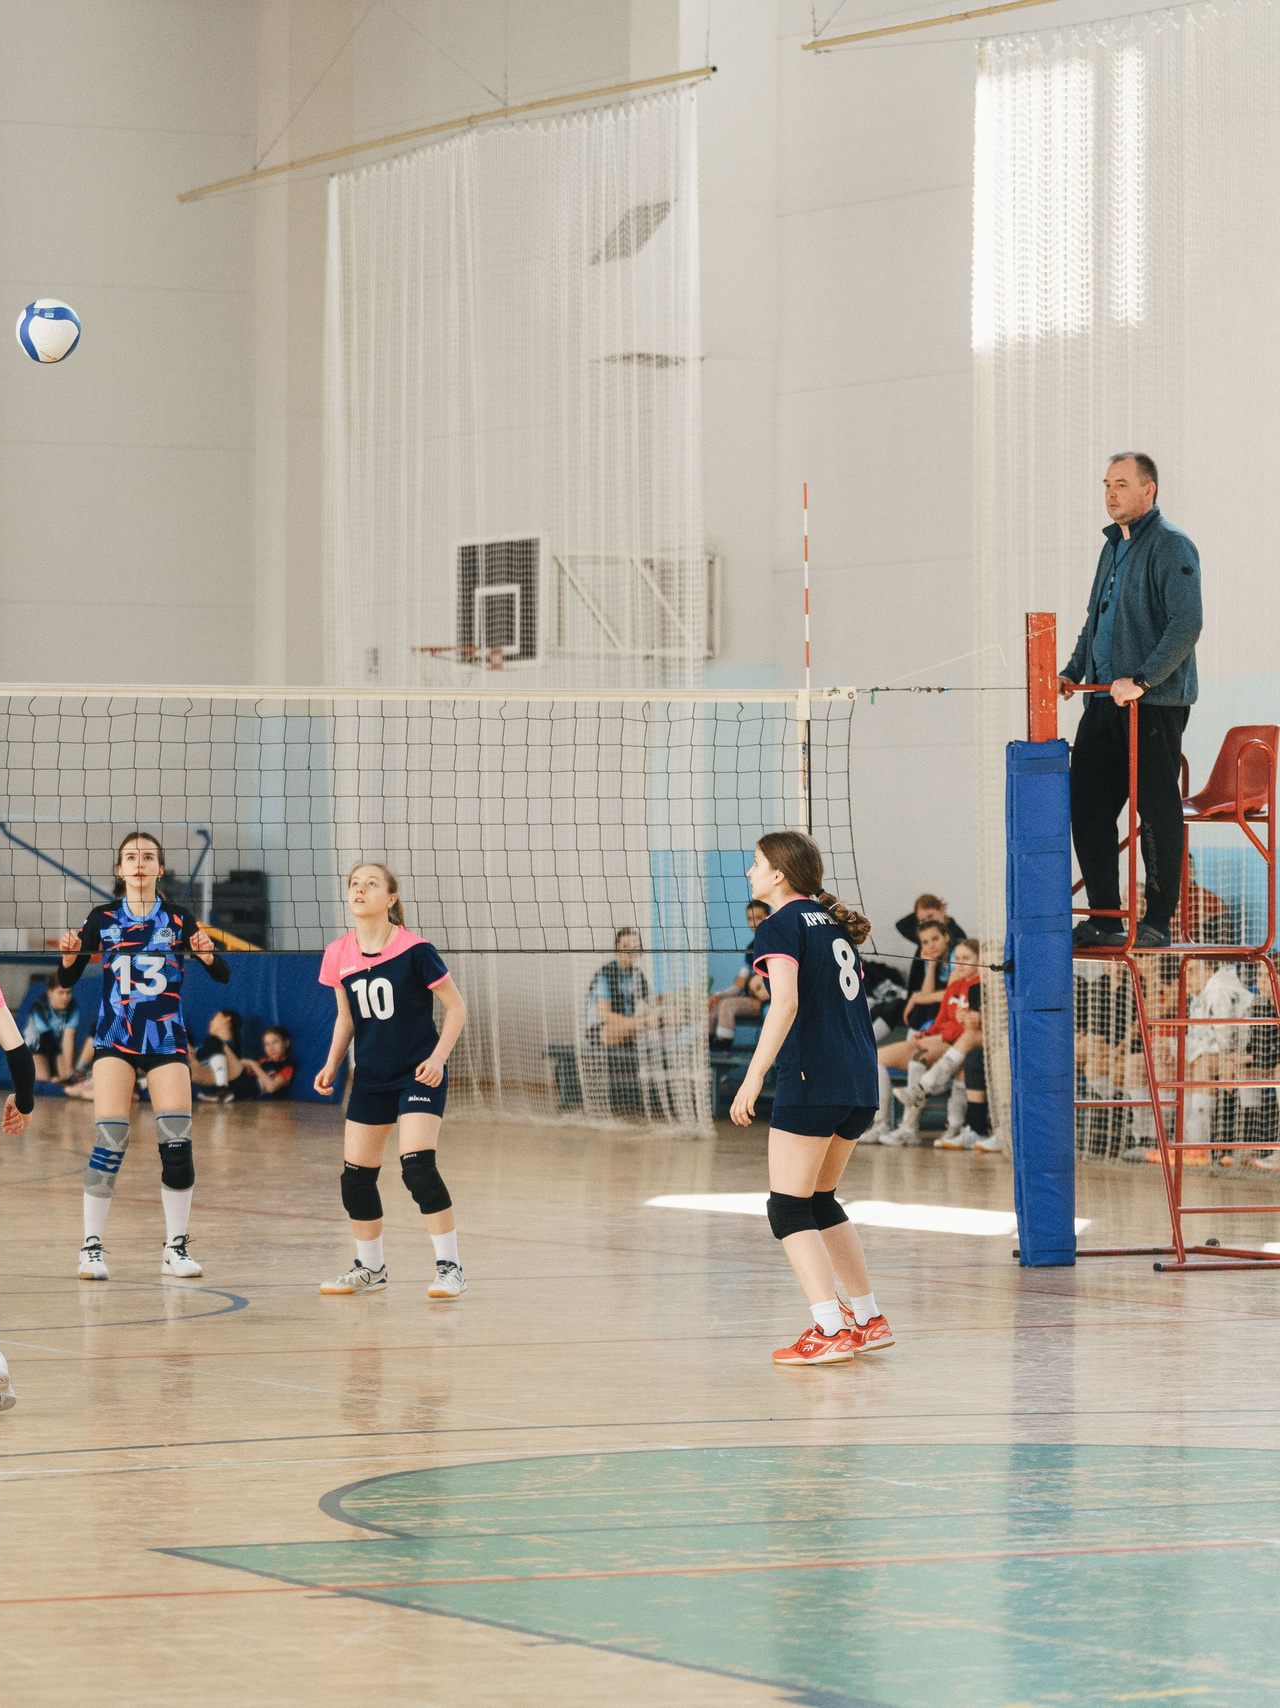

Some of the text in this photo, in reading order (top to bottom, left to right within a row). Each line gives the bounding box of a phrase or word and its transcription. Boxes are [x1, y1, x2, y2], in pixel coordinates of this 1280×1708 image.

[111, 955, 167, 996] 13
[832, 938, 860, 1001] 8
[351, 977, 395, 1020] 10
